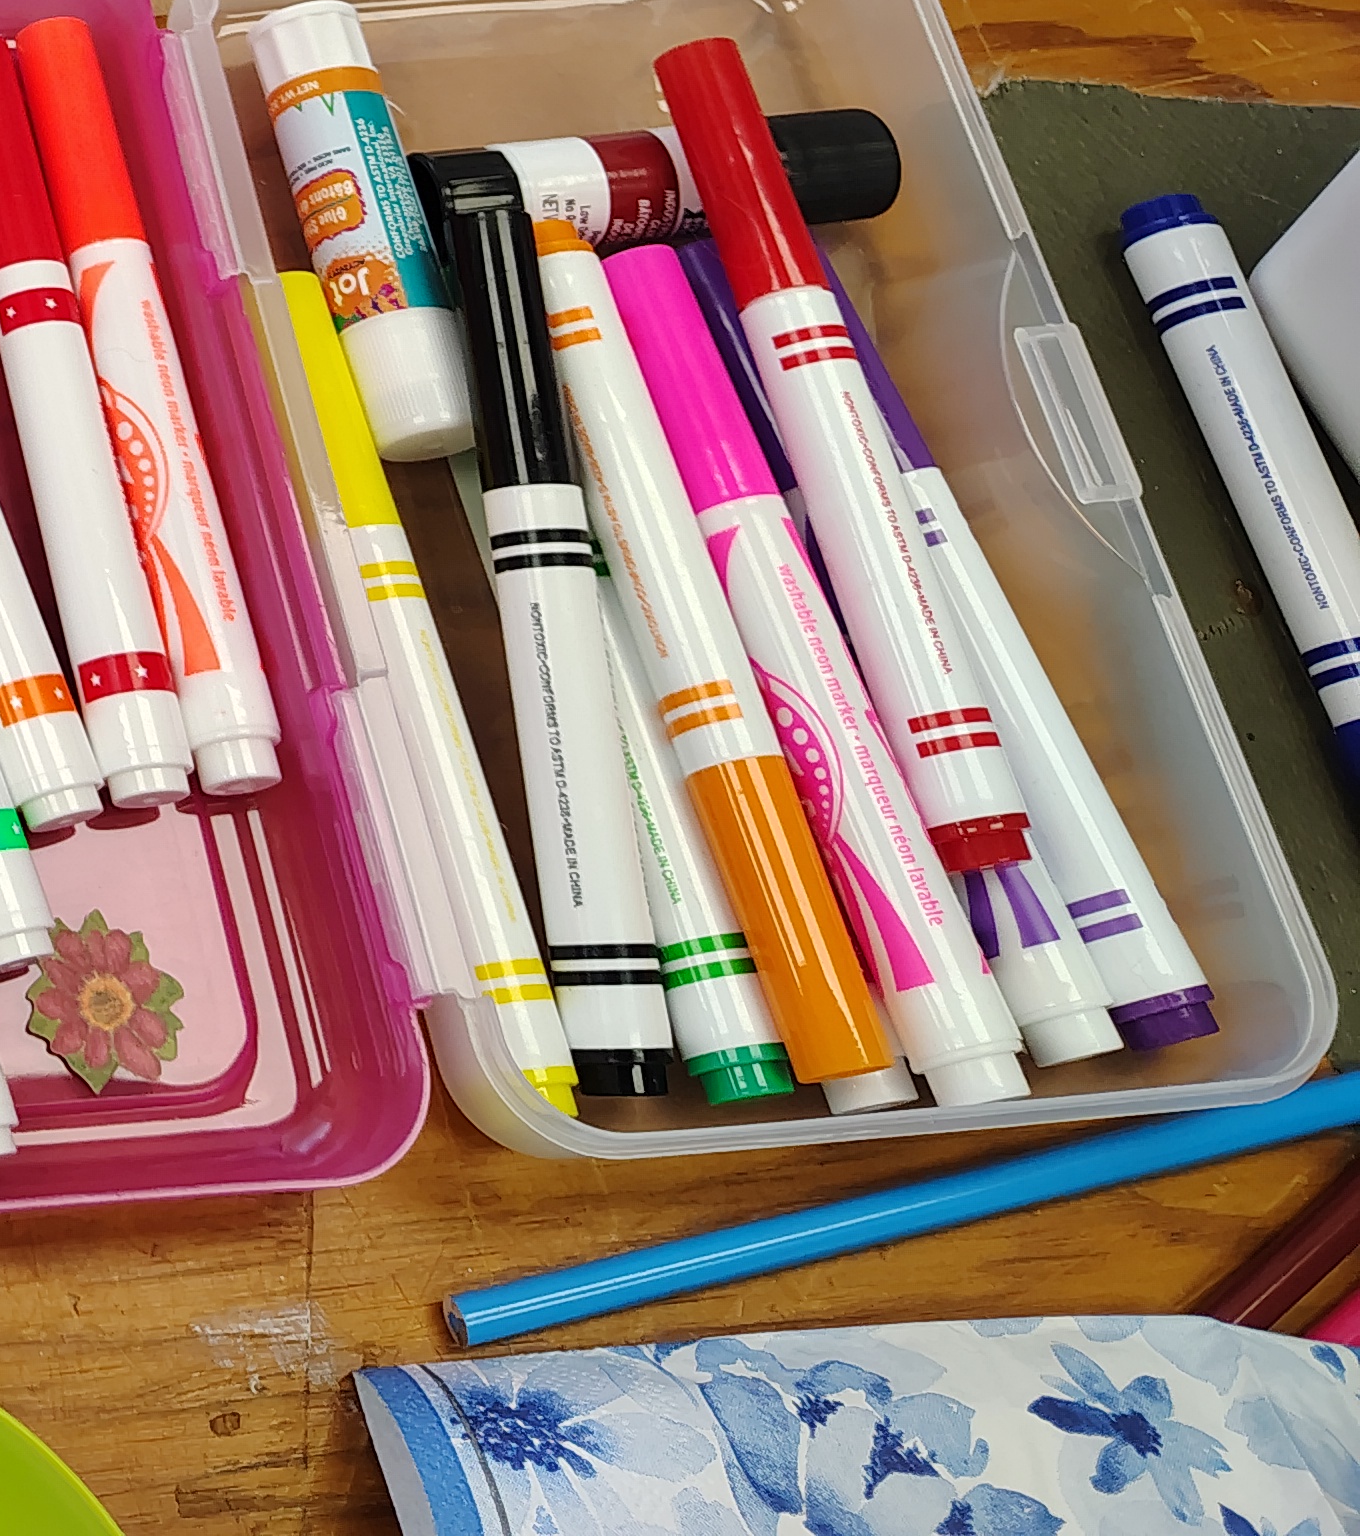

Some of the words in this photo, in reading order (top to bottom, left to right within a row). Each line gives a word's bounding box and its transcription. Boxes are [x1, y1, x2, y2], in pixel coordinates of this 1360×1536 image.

[375, 184, 386, 197] TO
[317, 205, 347, 227] Glue
[380, 199, 407, 258] CONFORMS
[329, 265, 370, 306] Jot
[779, 564, 817, 633] washable
[809, 636, 834, 674] neon
[827, 676, 859, 731] marker
[855, 745, 898, 821] marqueur
[890, 824, 916, 864] néon
[907, 867, 944, 925] lavable
